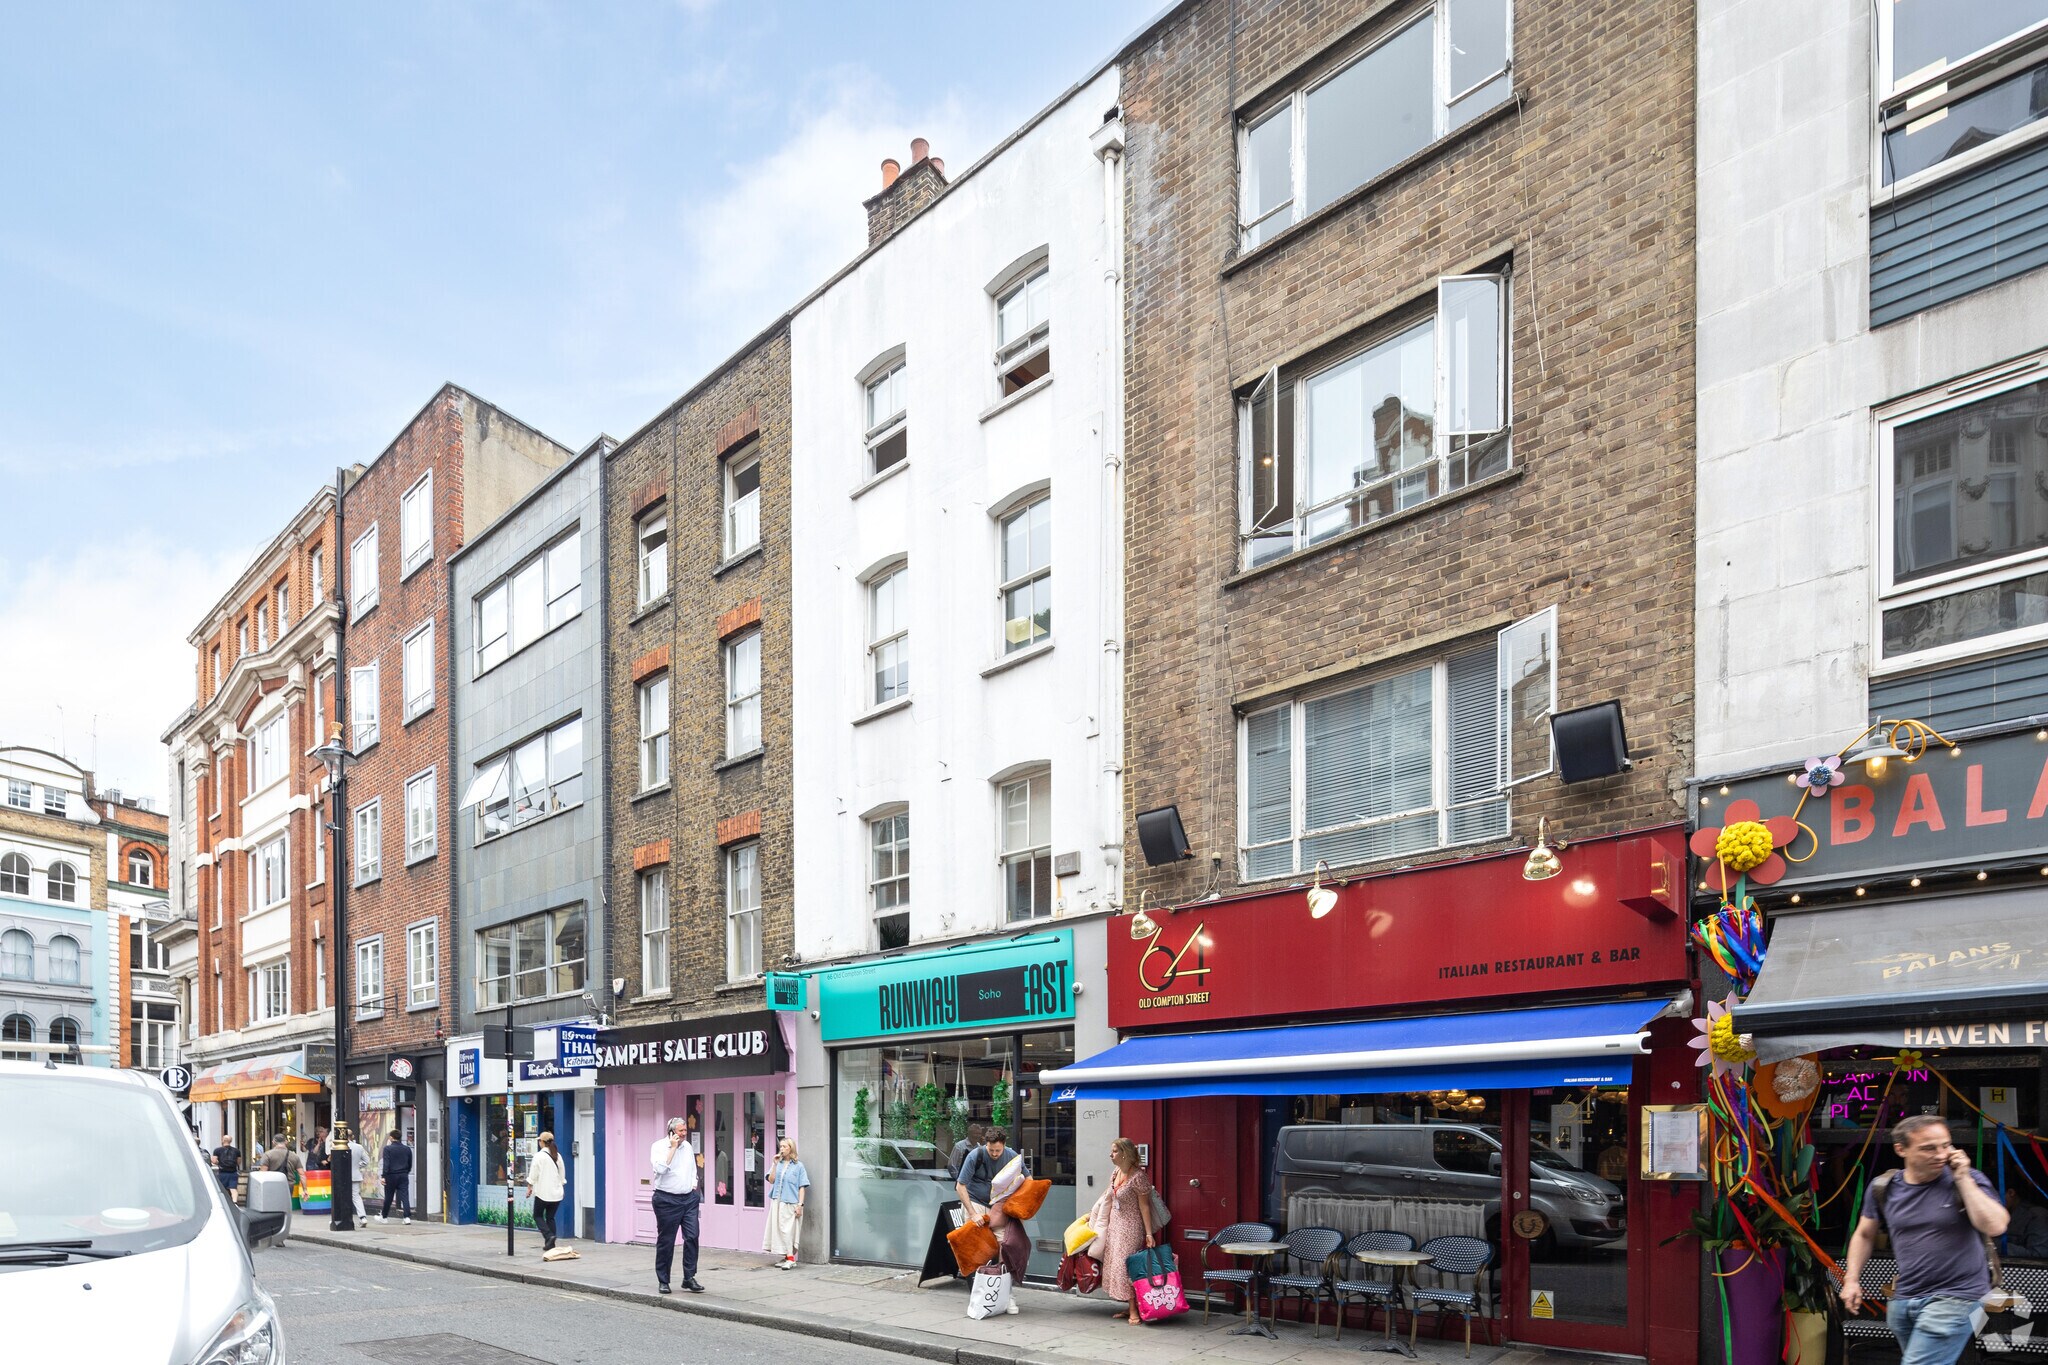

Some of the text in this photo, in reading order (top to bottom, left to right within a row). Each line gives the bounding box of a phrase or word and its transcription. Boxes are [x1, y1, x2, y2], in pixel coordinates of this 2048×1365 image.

[1138, 921, 1211, 992] 64
[1439, 947, 1641, 979] ITALIAN RESTAURANT & BAR
[1882, 942, 2012, 979] BALANS
[774, 979, 799, 993] RUNWAY
[879, 959, 1068, 1030] RUNWAY EAST
[978, 988, 1002, 1000] Soho
[1138, 991, 1211, 1010] OLD COMPTON STREET
[568, 1031, 597, 1040] Great
[1904, 1020, 2048, 1046] HAVEN F
[595, 1030, 769, 1068] SAMPLE SALE CLUB
